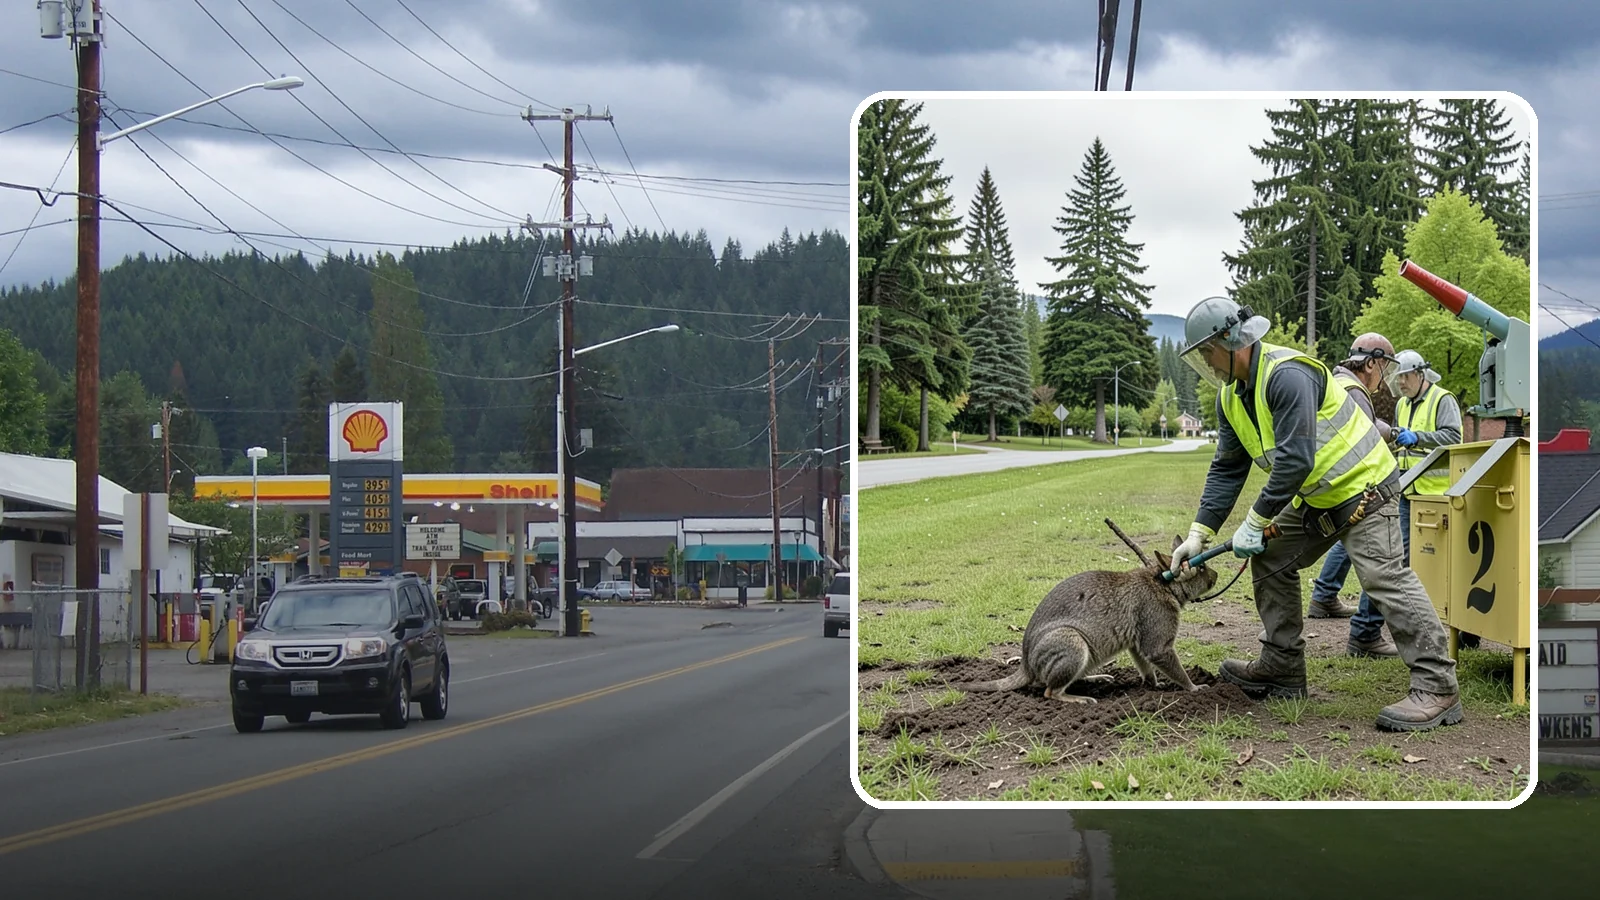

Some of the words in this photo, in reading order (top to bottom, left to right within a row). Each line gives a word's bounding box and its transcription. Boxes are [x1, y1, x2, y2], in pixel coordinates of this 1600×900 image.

[366, 480, 383, 490] 395
[490, 484, 547, 499] Shell
[366, 494, 383, 504] 405
[366, 508, 383, 518] 415
[366, 522, 383, 532] 429
[1467, 521, 1496, 614] 2
[1539, 643, 1566, 665] AID
[1539, 716, 1592, 738] WKENS
